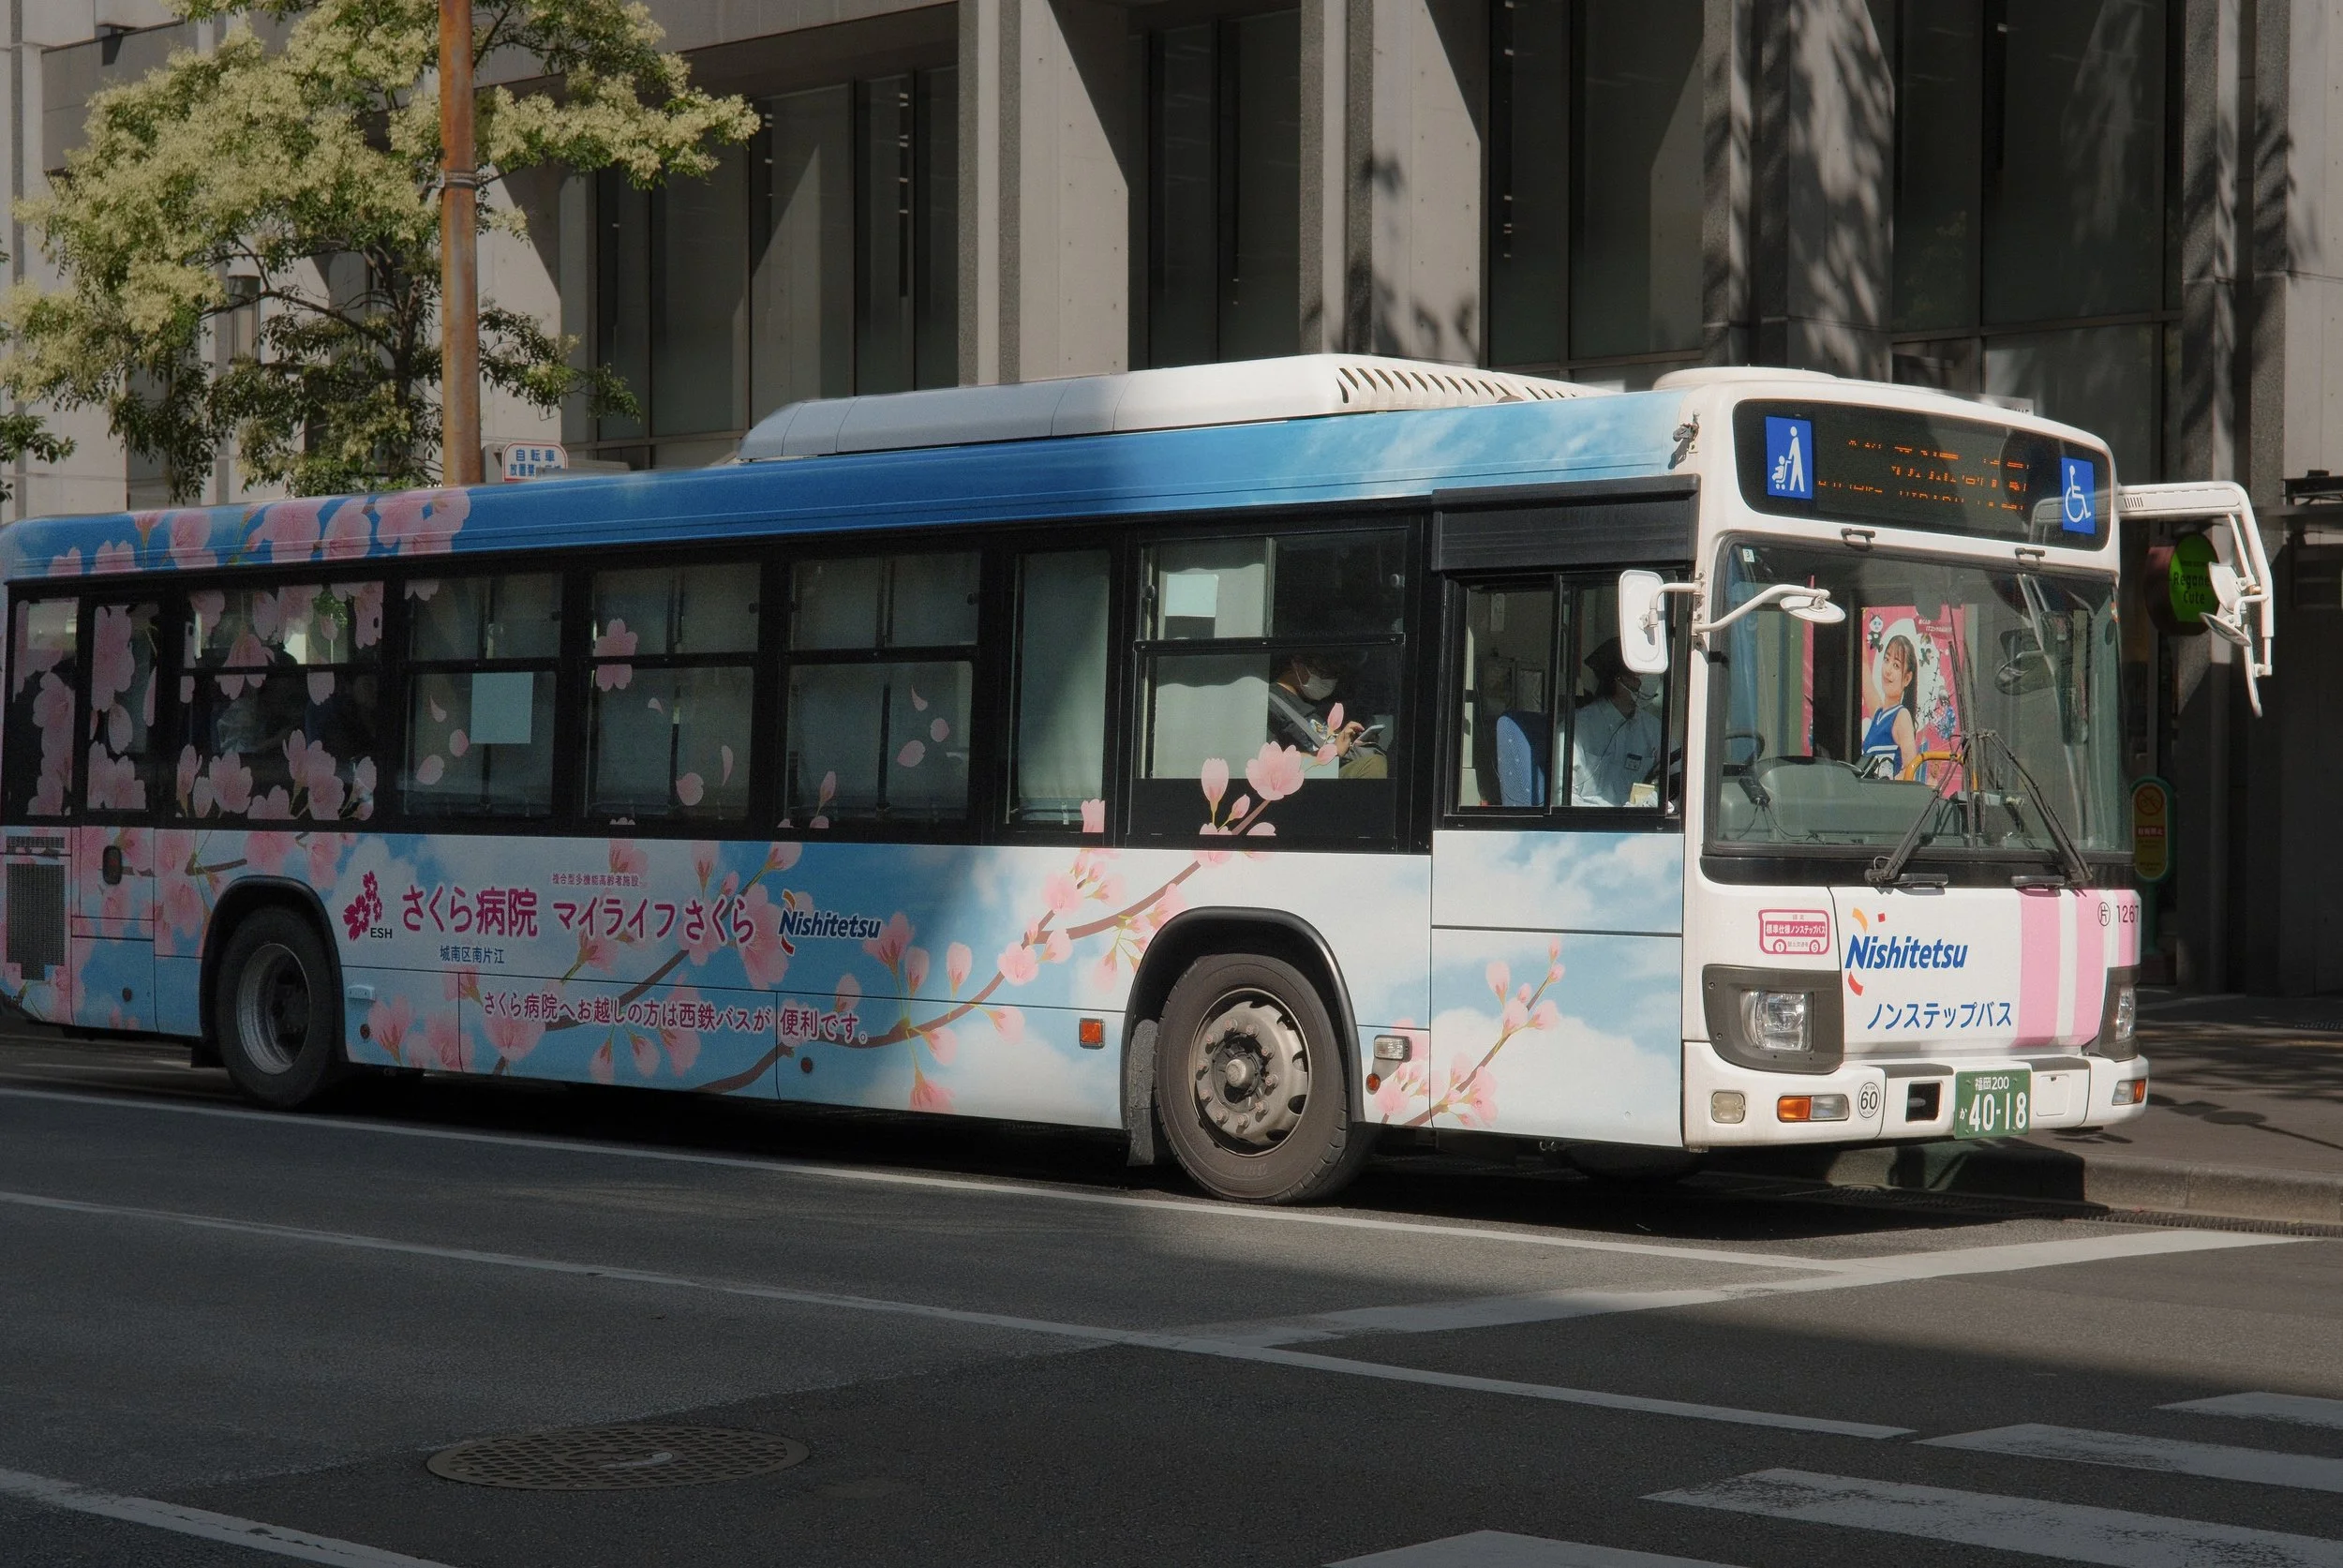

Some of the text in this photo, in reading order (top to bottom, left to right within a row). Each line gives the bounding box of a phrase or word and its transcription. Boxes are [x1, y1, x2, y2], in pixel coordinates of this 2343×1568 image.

[515, 449, 555, 462] 自転車
[402, 884, 538, 937] さくら病院
[2116, 904, 2140, 923] 1267
[370, 927, 393, 939] ESH
[778, 909, 881, 939] Nishitetsu
[440, 945, 505, 964] 城南区南片江
[1844, 933, 1968, 970] Nishitetsu
[1867, 1001, 2012, 1030] ノンステップバス
[1860, 1091, 1878, 1110] 60
[1968, 1091, 2027, 1132] 40-18
